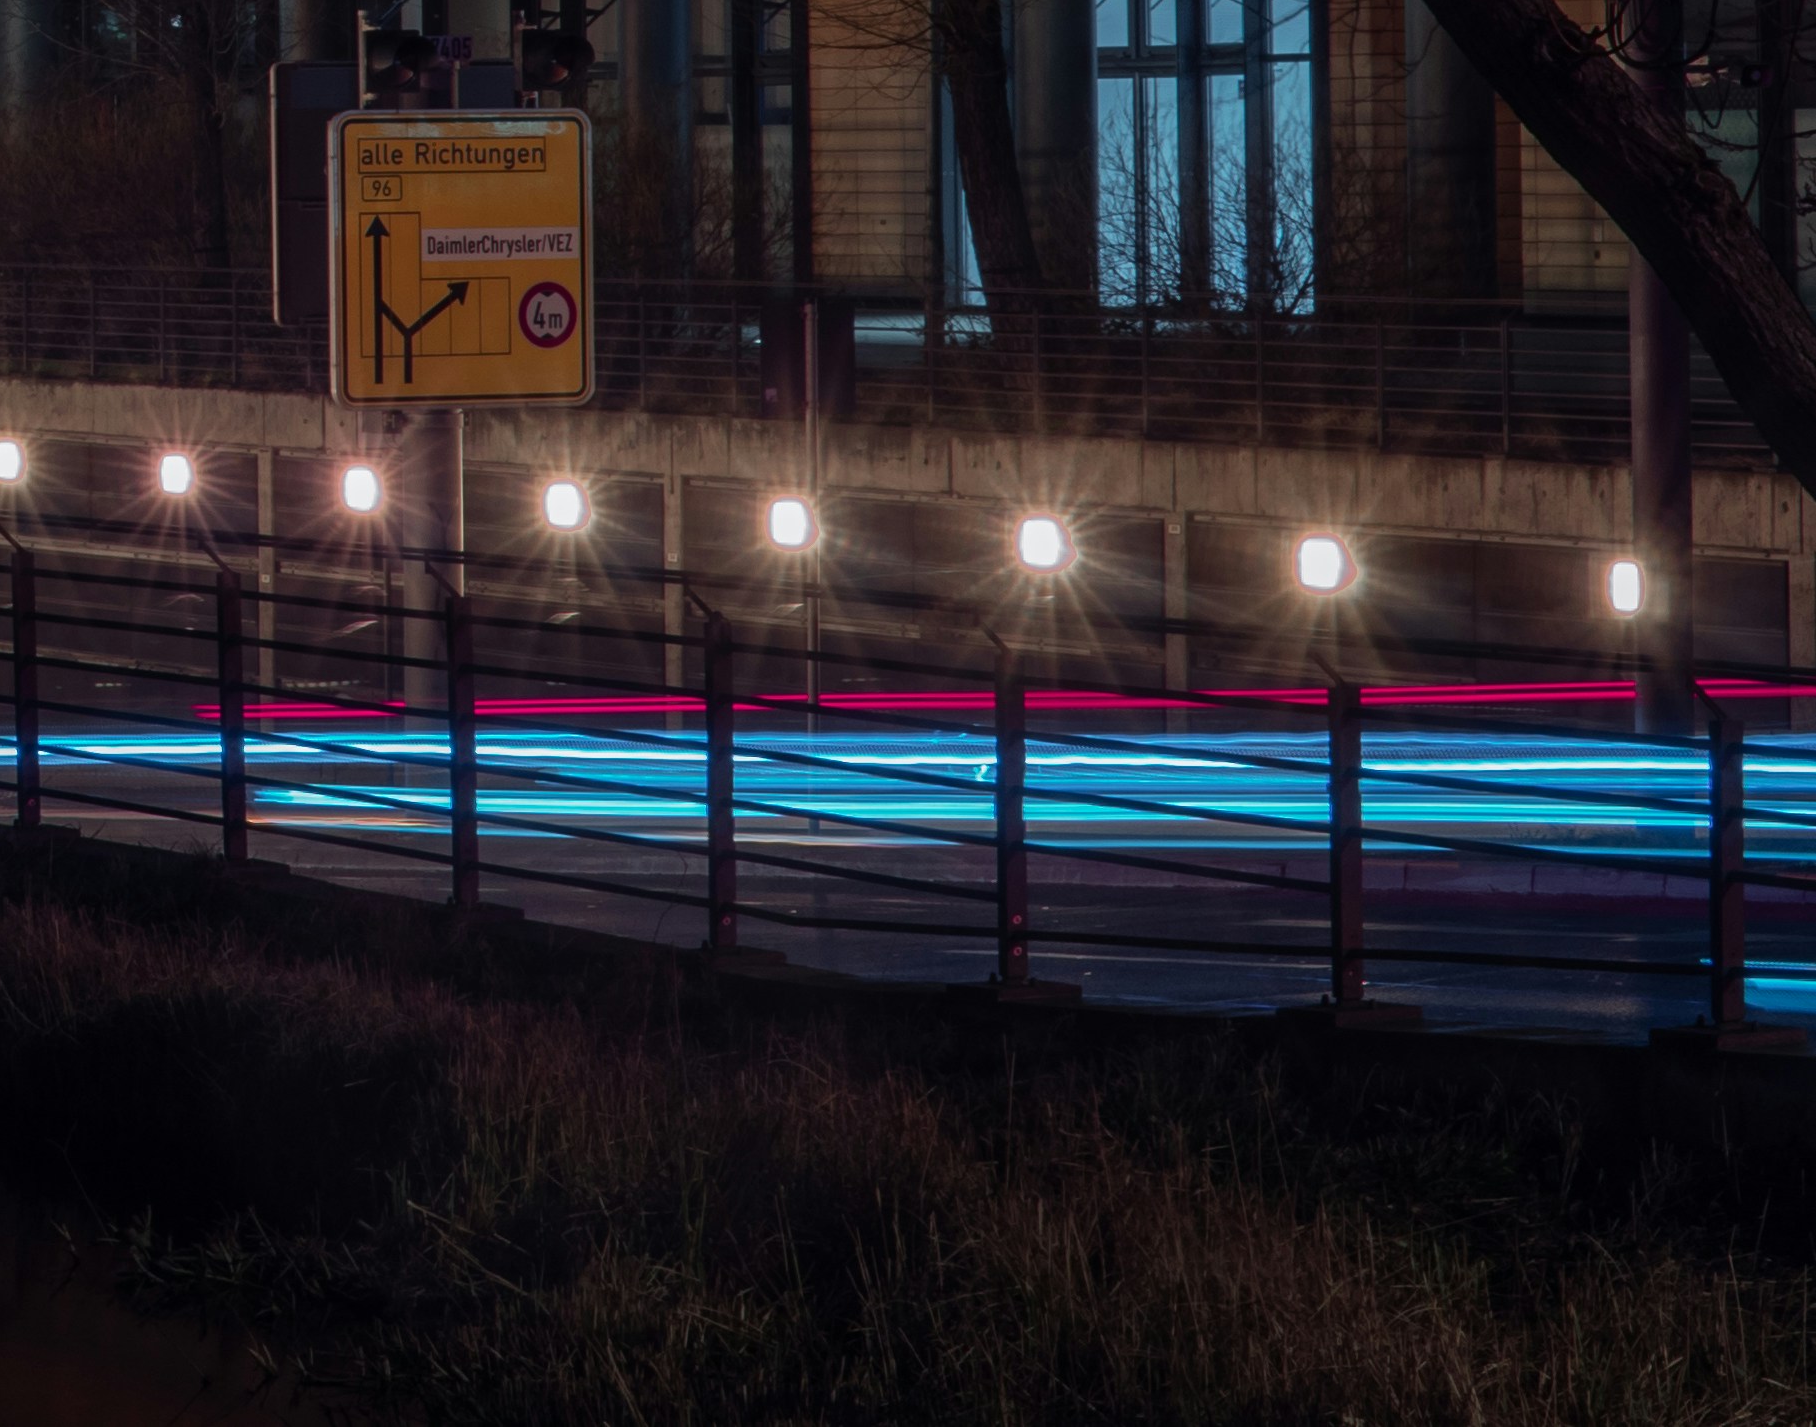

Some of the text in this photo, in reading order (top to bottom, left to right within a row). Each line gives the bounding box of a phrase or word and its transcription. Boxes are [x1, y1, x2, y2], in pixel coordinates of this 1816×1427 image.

[362, 142, 544, 169] alle Richtungen
[372, 180, 392, 197] 96
[427, 233, 573, 258] DaimlerChrysler/VEZ
